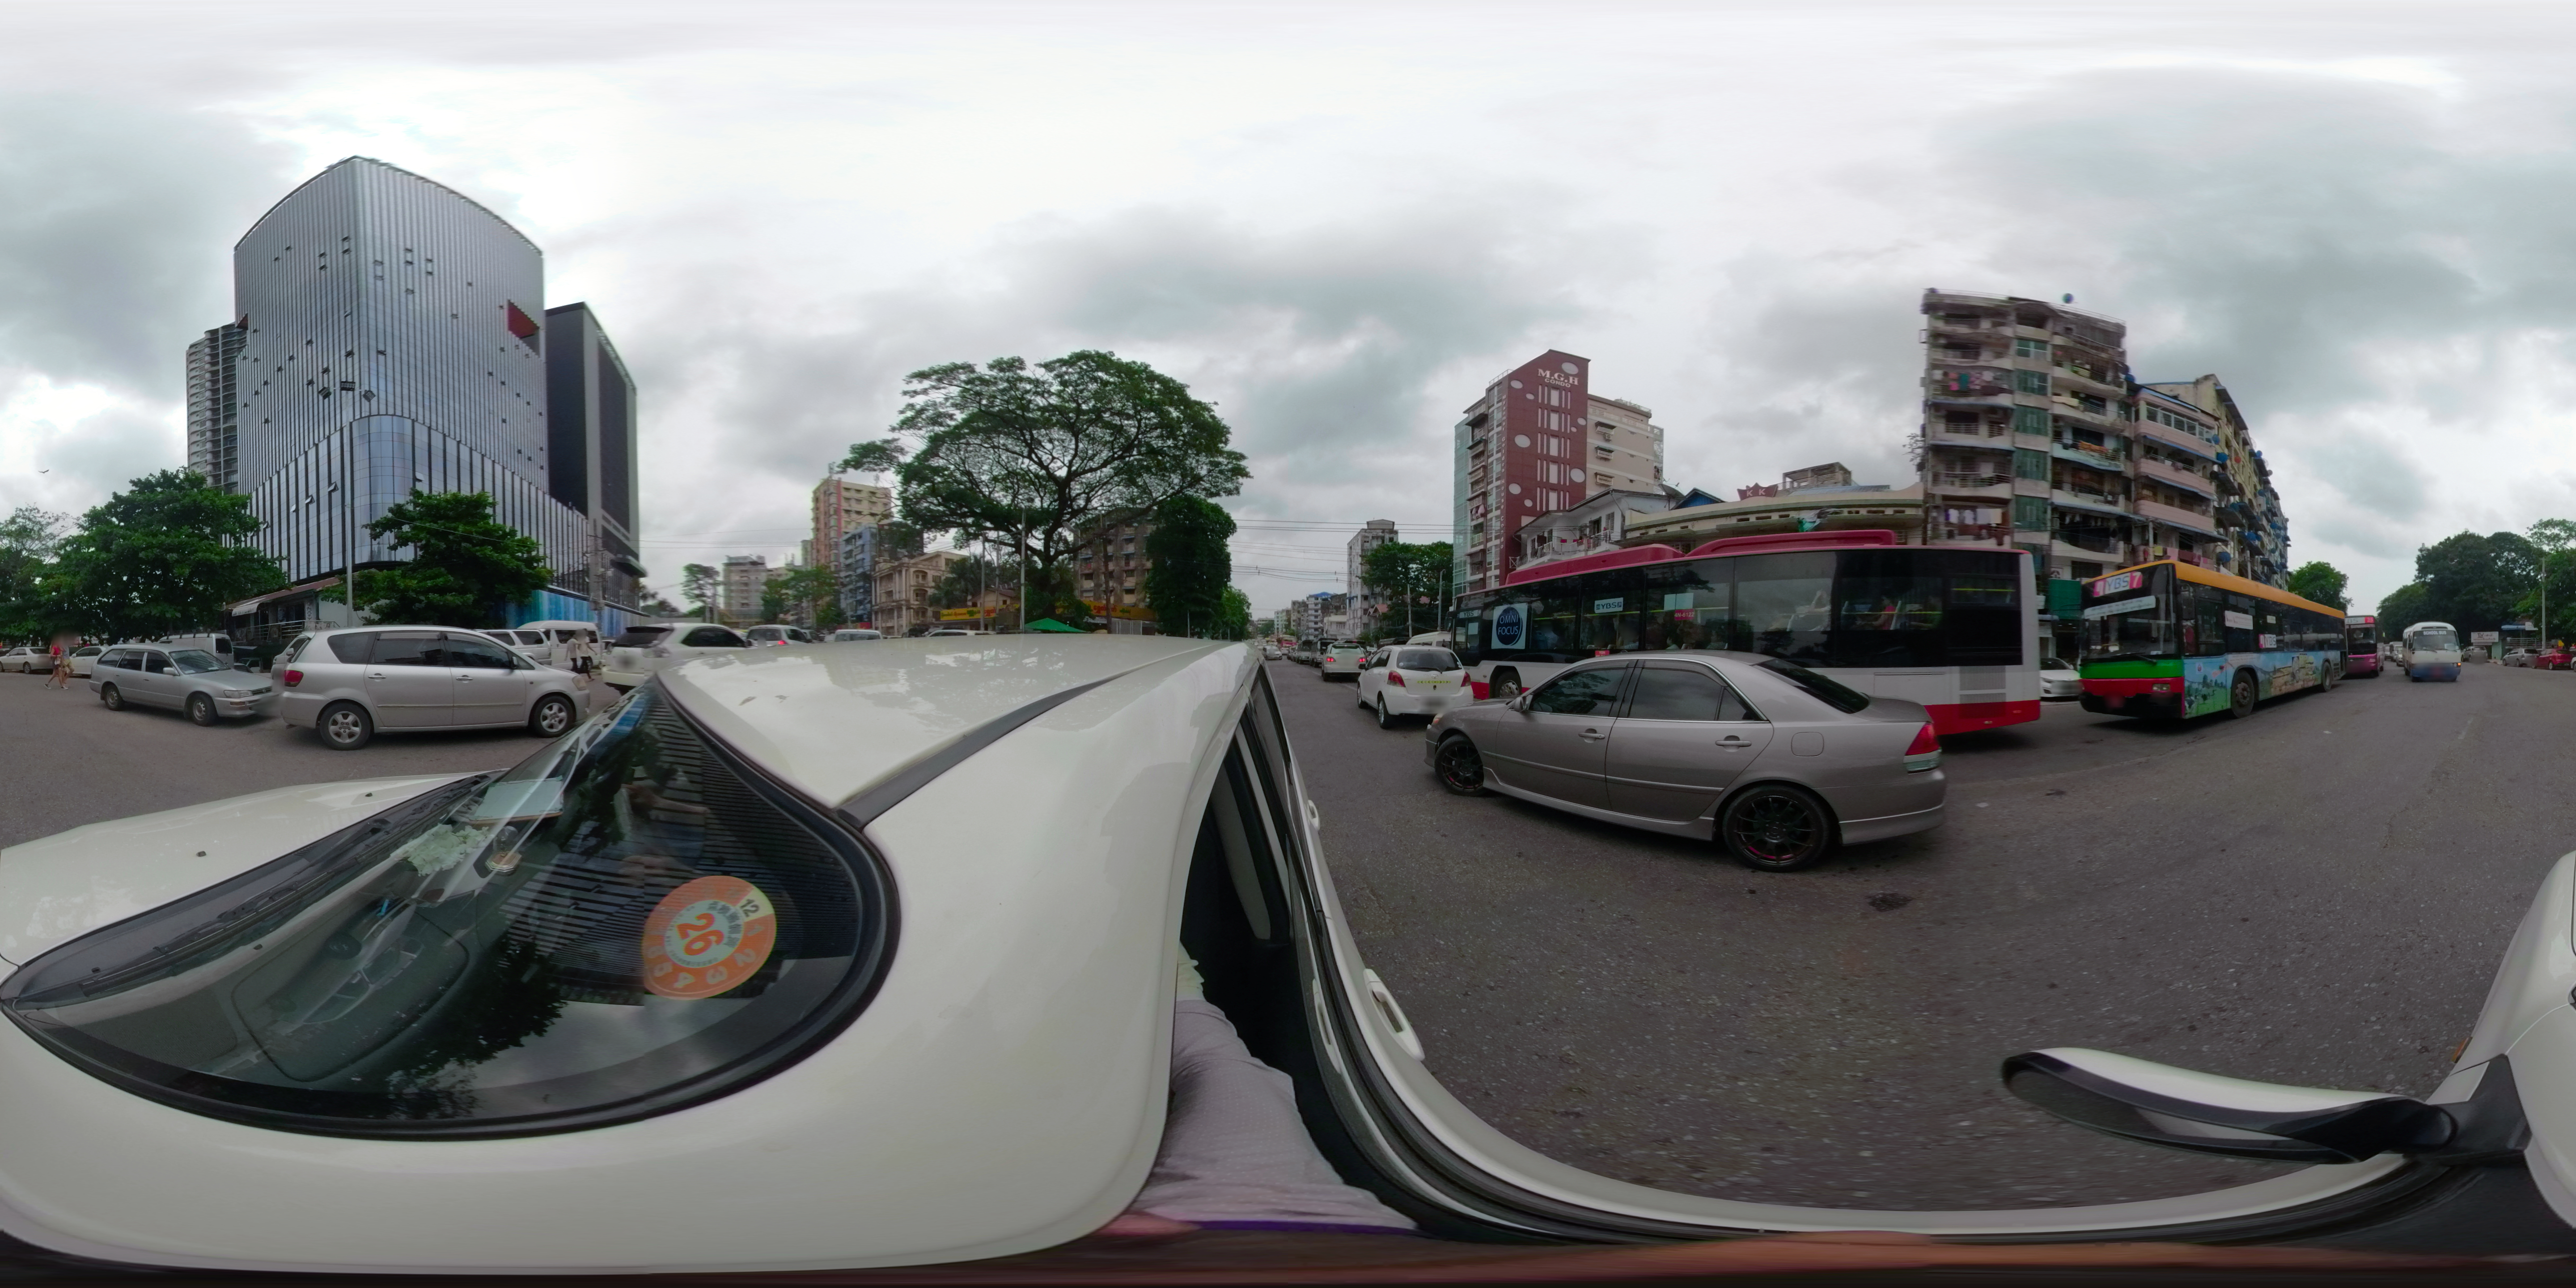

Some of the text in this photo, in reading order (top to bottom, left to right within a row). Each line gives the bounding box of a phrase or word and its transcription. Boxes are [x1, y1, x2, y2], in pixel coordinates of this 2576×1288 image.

[1538, 369, 1579, 385] M.G.H
[1545, 378, 1571, 388] CONDO
[2106, 571, 2142, 590] YBS 7
[1500, 615, 1518, 624] OMNI
[1498, 626, 1518, 635] FOCUS
[2265, 636, 2276, 646] YBS
[739, 898, 760, 918] 12
[676, 913, 724, 956] 26
